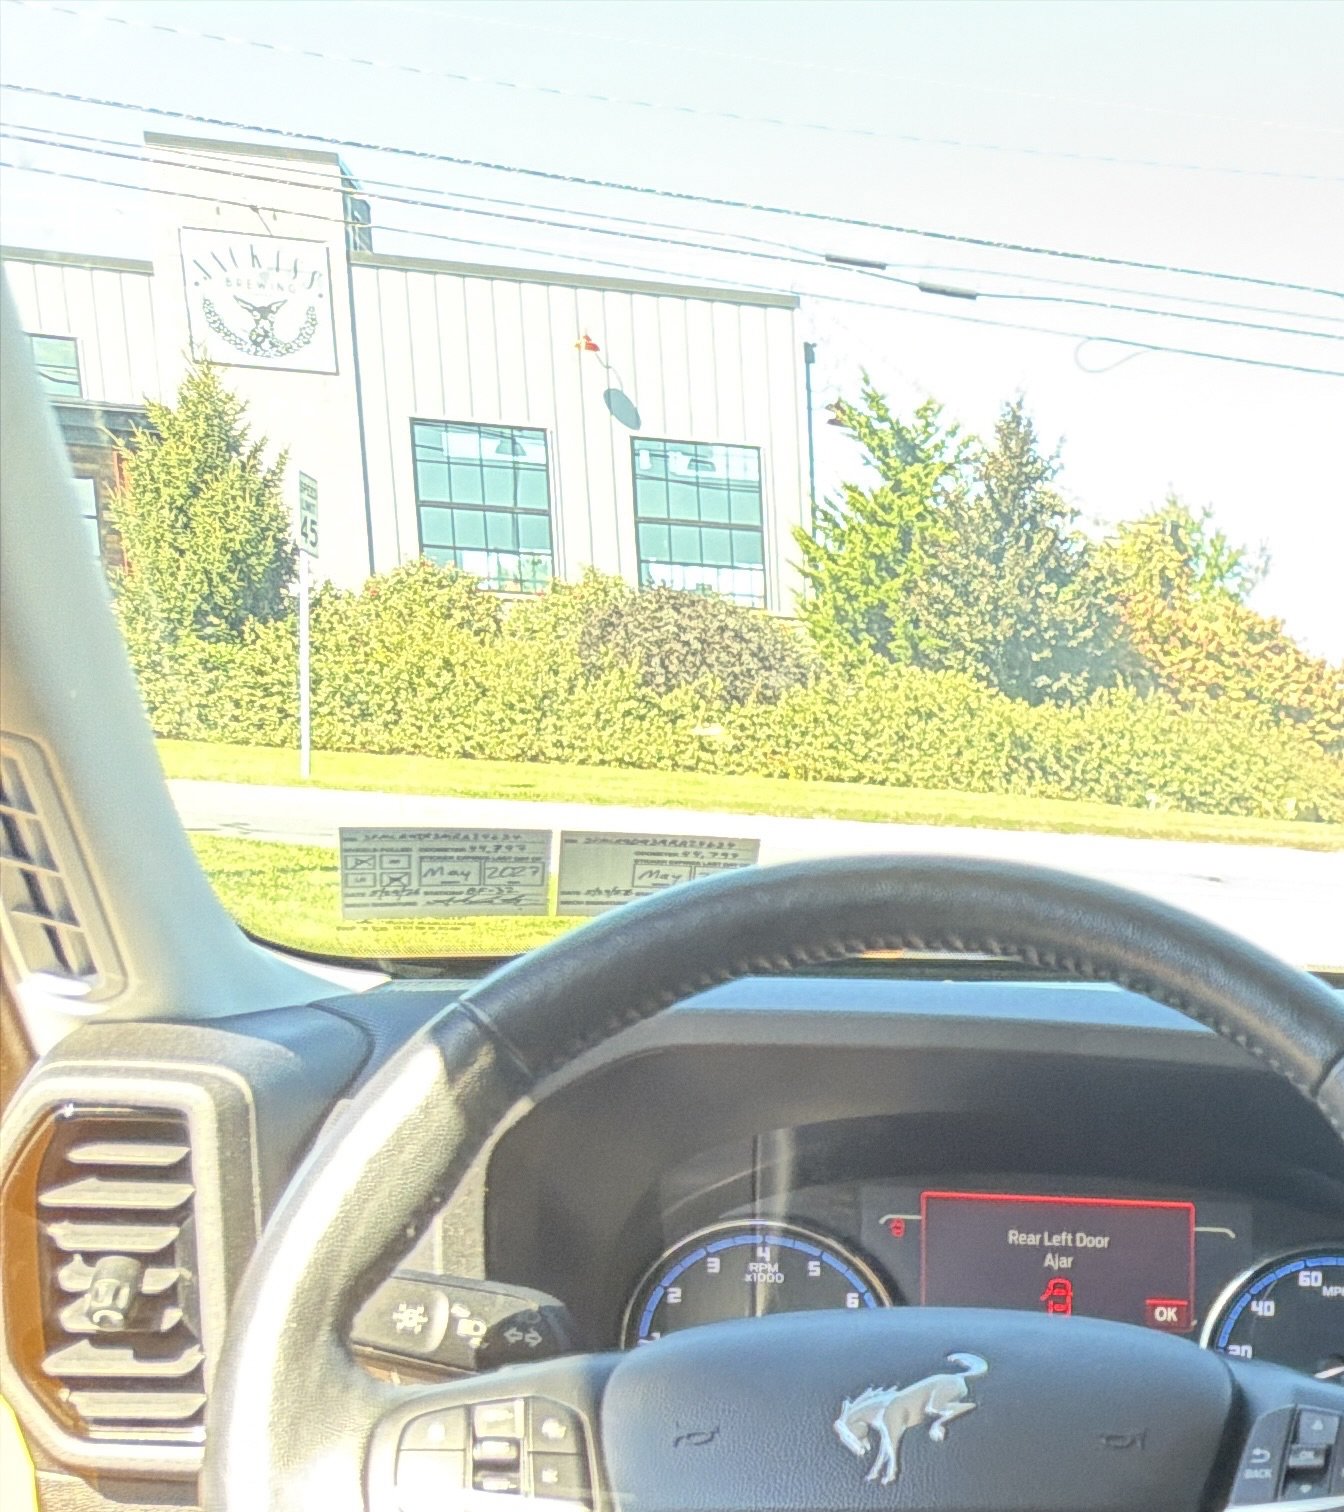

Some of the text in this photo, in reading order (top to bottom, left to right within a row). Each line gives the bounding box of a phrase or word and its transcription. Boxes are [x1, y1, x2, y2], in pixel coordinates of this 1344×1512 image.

[301, 515, 318, 548] 45
[422, 866, 472, 881] May
[637, 869, 683, 886] May
[1007, 1229, 1111, 1249] Rear Left Door
[756, 1246, 771, 1262] 4
[1043, 1252, 1074, 1271] Ajar
[706, 1257, 721, 1274] 3
[749, 1262, 779, 1273] RPM
[807, 1260, 821, 1277] 5
[744, 1272, 785, 1284] x1000
[1298, 1271, 1323, 1287] 60
[667, 1287, 682, 1304] 2
[846, 1292, 860, 1309] 6
[1154, 1306, 1178, 1322] OK
[1251, 1300, 1275, 1317] 40
[1243, 1468, 1273, 1479] BACK
